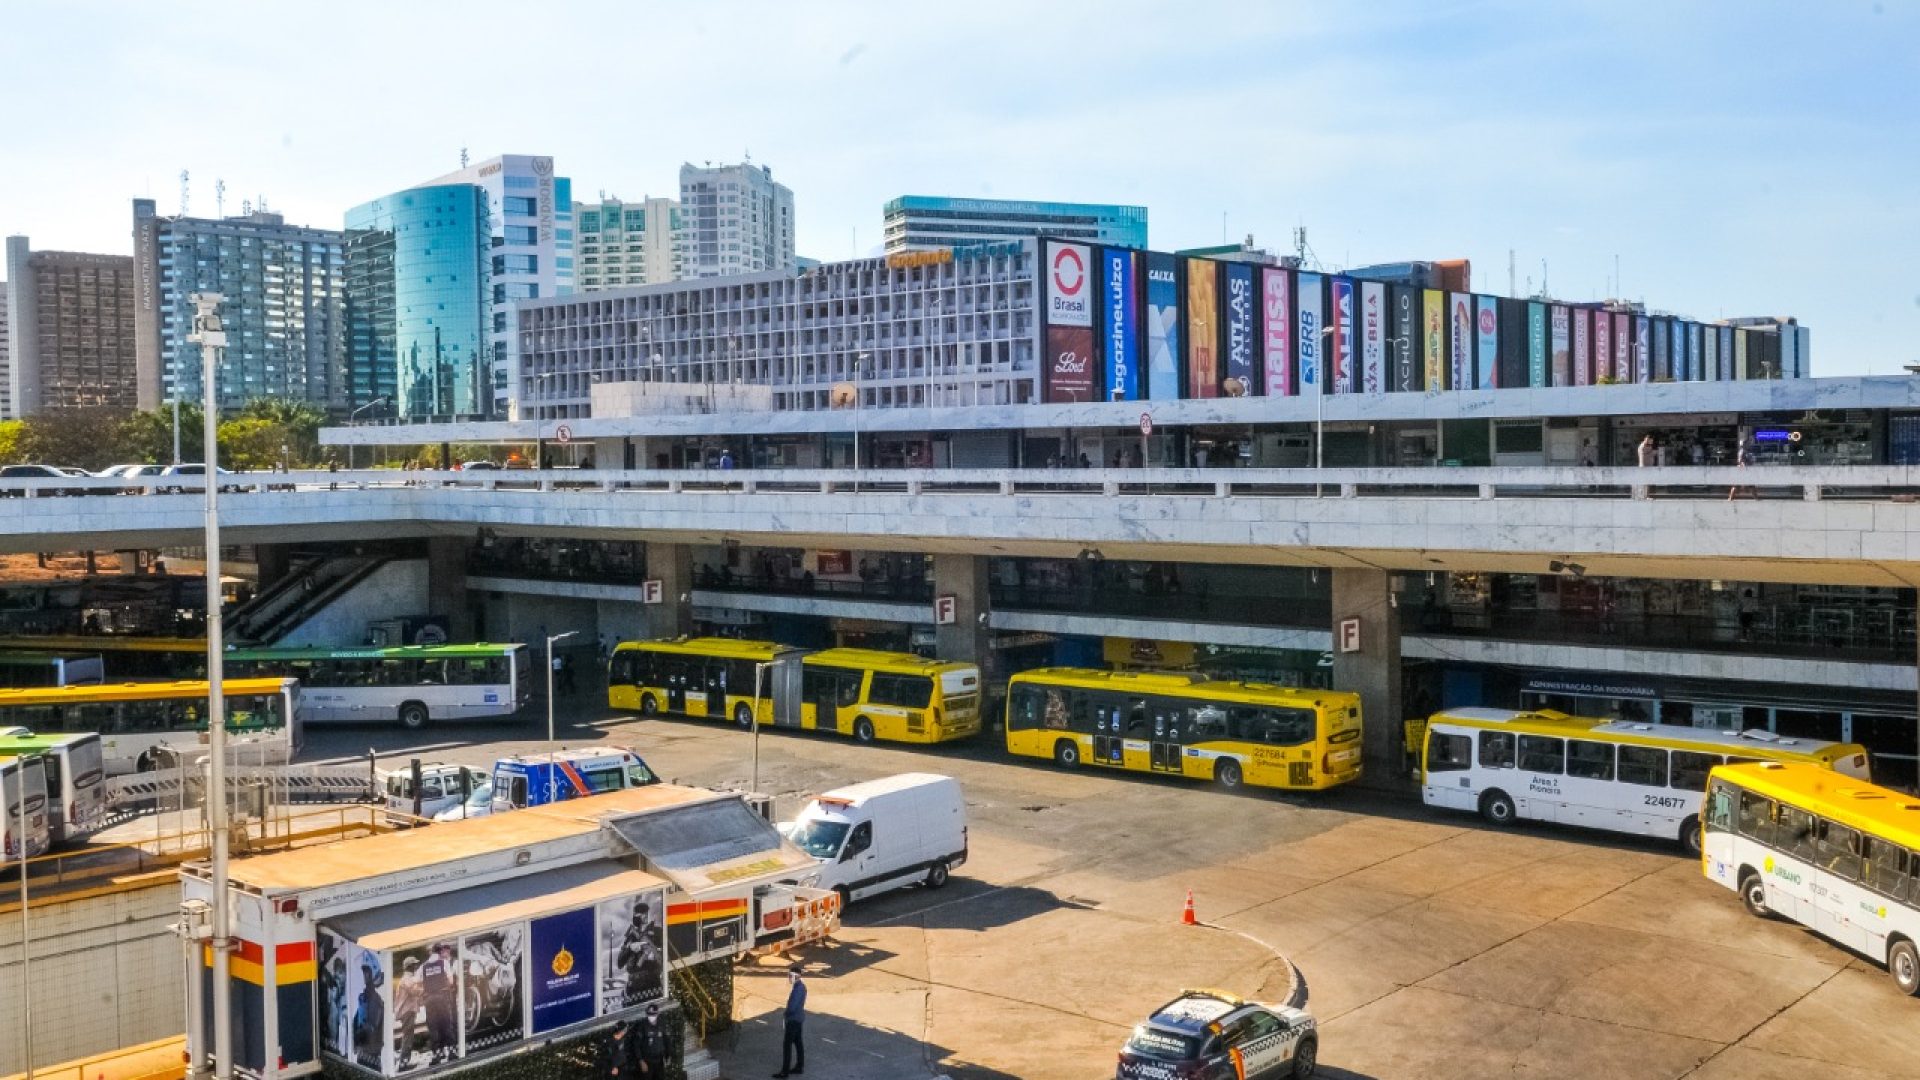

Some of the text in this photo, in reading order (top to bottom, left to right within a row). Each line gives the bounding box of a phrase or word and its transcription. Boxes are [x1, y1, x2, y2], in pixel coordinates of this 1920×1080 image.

[540, 177, 551, 241] WINDSOR
[142, 224, 152, 310] MANHATTAN PLAZA
[818, 257, 885, 275] SHOPPING
[1149, 270, 1175, 282] CAIXA
[1054, 297, 1085, 312] Brasal
[1230, 278, 1245, 366] ATLAS
[1302, 310, 1313, 358] BRB
[648, 583, 657, 601] F
[939, 599, 951, 622] F
[1344, 623, 1356, 649] F
[1529, 680, 1656, 696] ADMINISTRAÇÃO DA RODOVIÁRIA
[1553, 777, 1558, 786] 2
[1644, 794, 1685, 809] 224677
[1774, 866, 1801, 885] URBANO
